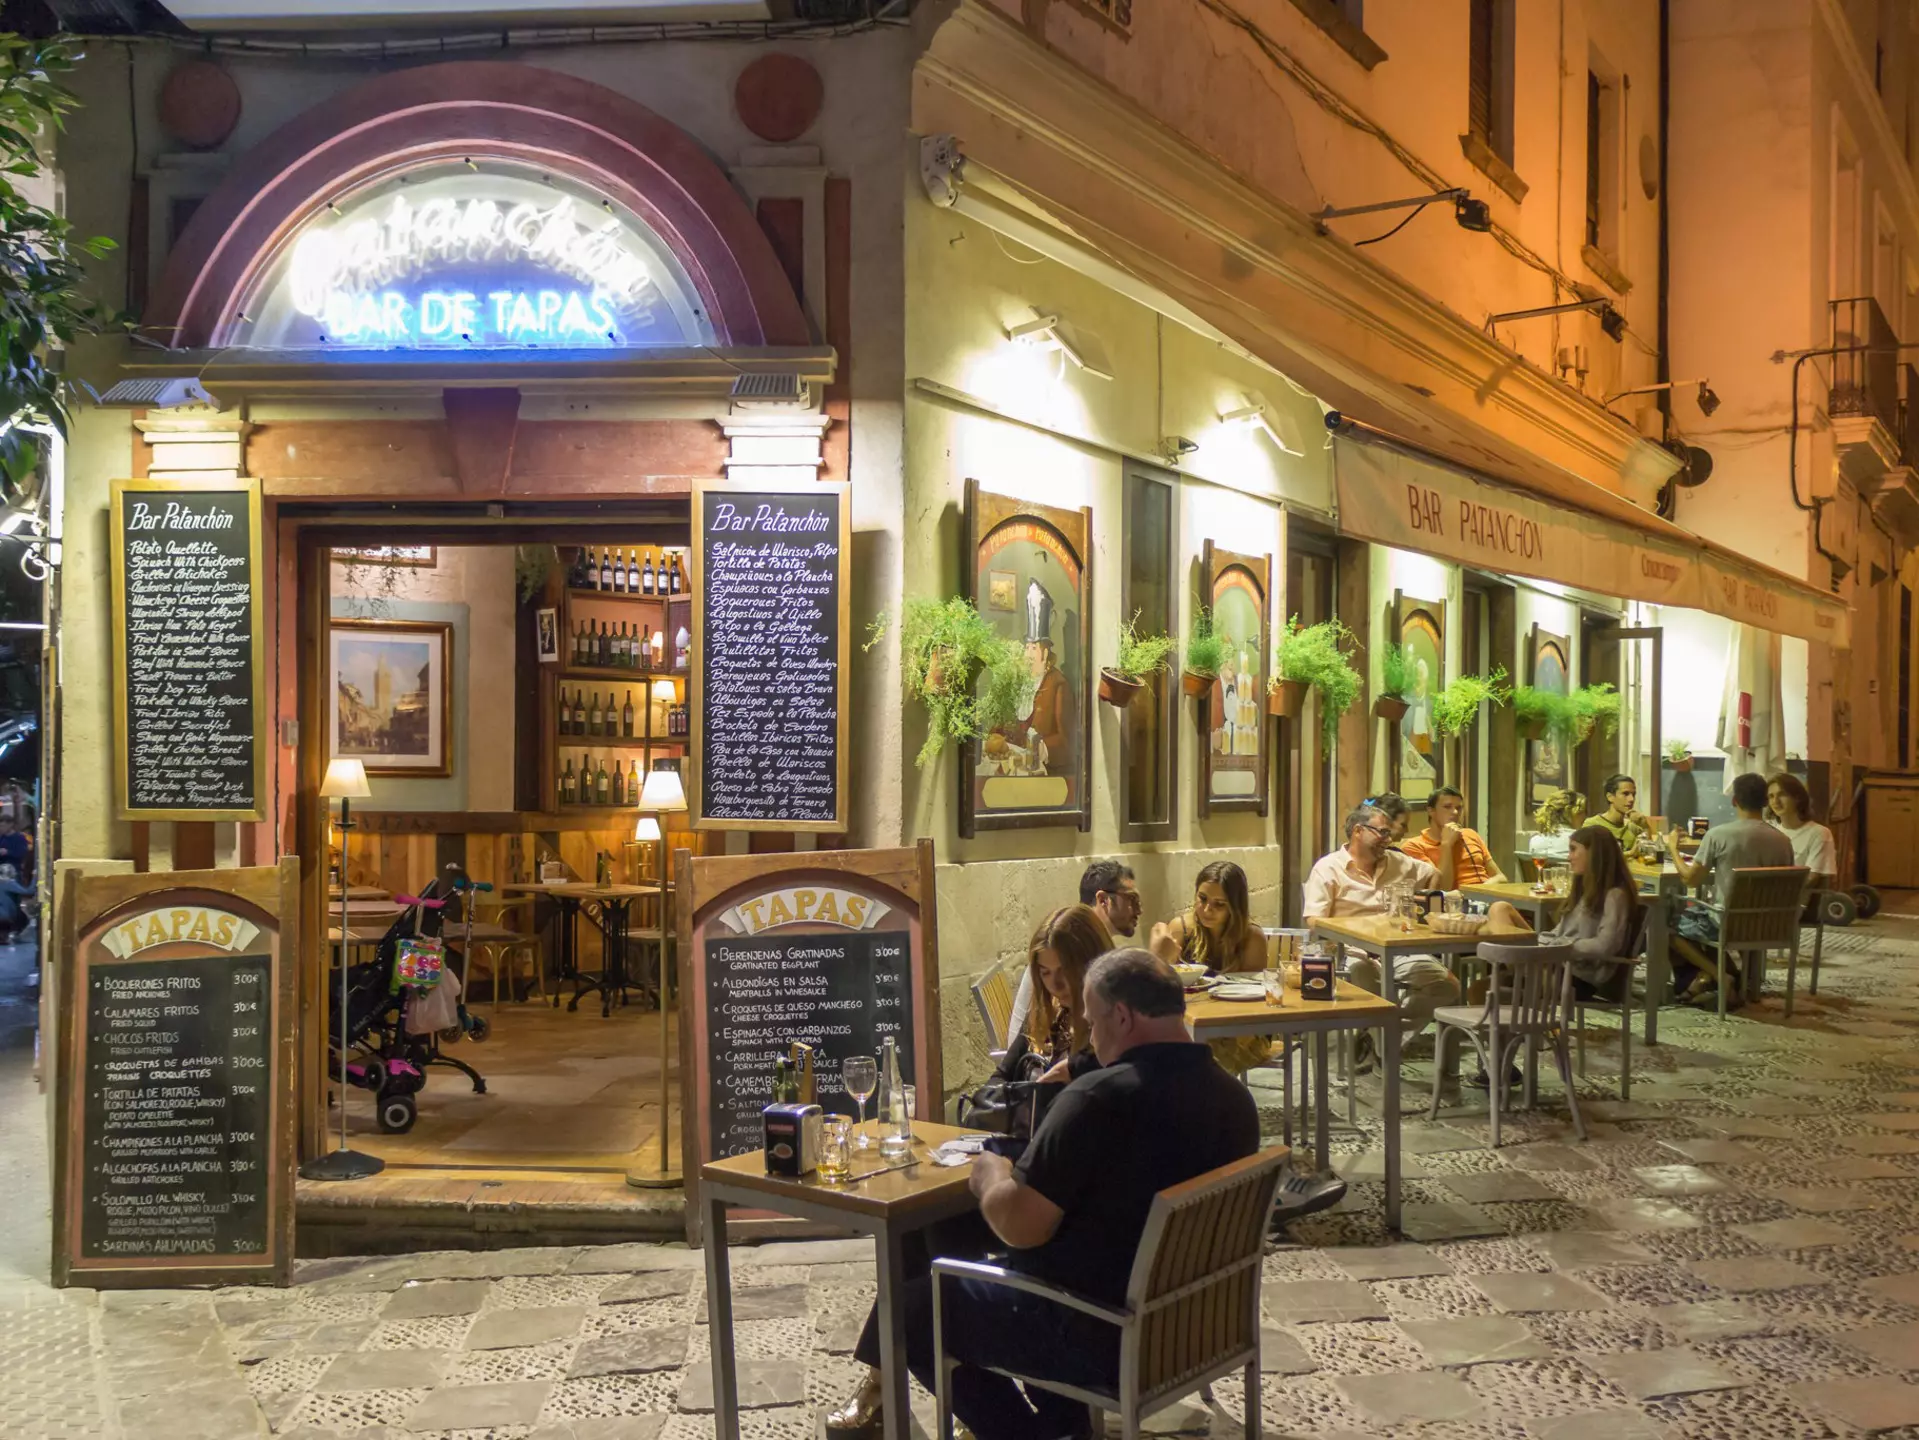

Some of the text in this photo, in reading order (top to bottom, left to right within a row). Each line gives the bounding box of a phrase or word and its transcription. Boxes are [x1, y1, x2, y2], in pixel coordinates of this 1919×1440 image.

[330, 290, 617, 336] BAR DE TAPAS
[127, 502, 161, 530] Bar
[710, 503, 751, 531] Bar
[1407, 484, 1543, 561] BAR PATANCHON
[130, 539, 162, 556] Potato
[758, 543, 771, 557] de
[813, 543, 838, 560] Pulpo
[129, 556, 171, 571] Spinach
[712, 556, 807, 569] Tortilla de Patatas
[130, 569, 173, 580] Grilled
[783, 570, 793, 582] la
[794, 569, 833, 582] Plancha
[711, 582, 830, 598] Espinacas con Garbanzos
[711, 594, 815, 614] Boquerones Fritos
[774, 608, 789, 620] al
[711, 620, 742, 633] Pulpo
[753, 621, 765, 631] la
[711, 632, 765, 644] Solomillo
[766, 633, 780, 644] al
[780, 645, 819, 656] Fritas
[711, 656, 807, 672] Croquetas de Queso
[711, 668, 772, 685] Berenjenas
[788, 695, 826, 707] Salsa
[711, 705, 732, 718] Pez
[733, 707, 775, 720] Espada
[711, 717, 830, 733] Brocheta de Cordero
[711, 731, 835, 744] Costillas Fritas
[711, 742, 732, 755] Pan
[732, 743, 747, 755] de
[711, 754, 828, 769] Paella de Mariscos
[761, 769, 776, 780] de
[711, 780, 744, 792] Queso
[744, 780, 760, 793] de
[740, 890, 867, 931] TAPAS
[120, 909, 238, 953] TAPAS
[719, 947, 782, 962] BERENJENAS
[786, 947, 845, 960] GRATINADAS
[729, 961, 820, 970] GRATINATED EGGPLANT
[104, 976, 201, 991] BOQUERONES FRITOS
[782, 977, 796, 987] EN
[799, 975, 829, 986] SALSA
[728, 989, 772, 998] MEATBALLS
[774, 989, 783, 997] IN
[103, 1005, 200, 1019] CALAMARES FRITOS
[722, 1002, 772, 1015] CROQUETAS
[773, 1003, 786, 1012] DE
[786, 1001, 816, 1012] QUESO
[817, 999, 863, 1010] MANCHEGO
[731, 1014, 761, 1023] CHEESE
[103, 1032, 180, 1044] CHOCOS FRITOS
[722, 1027, 774, 1041] ESPINACAS
[776, 1027, 796, 1037] CON
[796, 1024, 852, 1037] GARBANZOS
[731, 1036, 763, 1047] SPINACH
[765, 1036, 784, 1045] WITH
[104, 1055, 265, 1071] CROQUETAS DE GAMBAS 3'00€
[812, 1058, 839, 1069] SAUCE
[149, 1068, 212, 1080] CROQUETTES
[102, 1087, 144, 1100] TORTILLA
[146, 1087, 160, 1098] DE
[161, 1087, 201, 1098] PATATAS
[182, 1132, 256, 1146] PLANCHA 3'00€
[101, 1161, 223, 1175] ALCACHOFAS PLANCHA
[101, 1192, 153, 1206] SOLOMILLO
[101, 1239, 216, 1253] SARDINAS AHUMADAS
